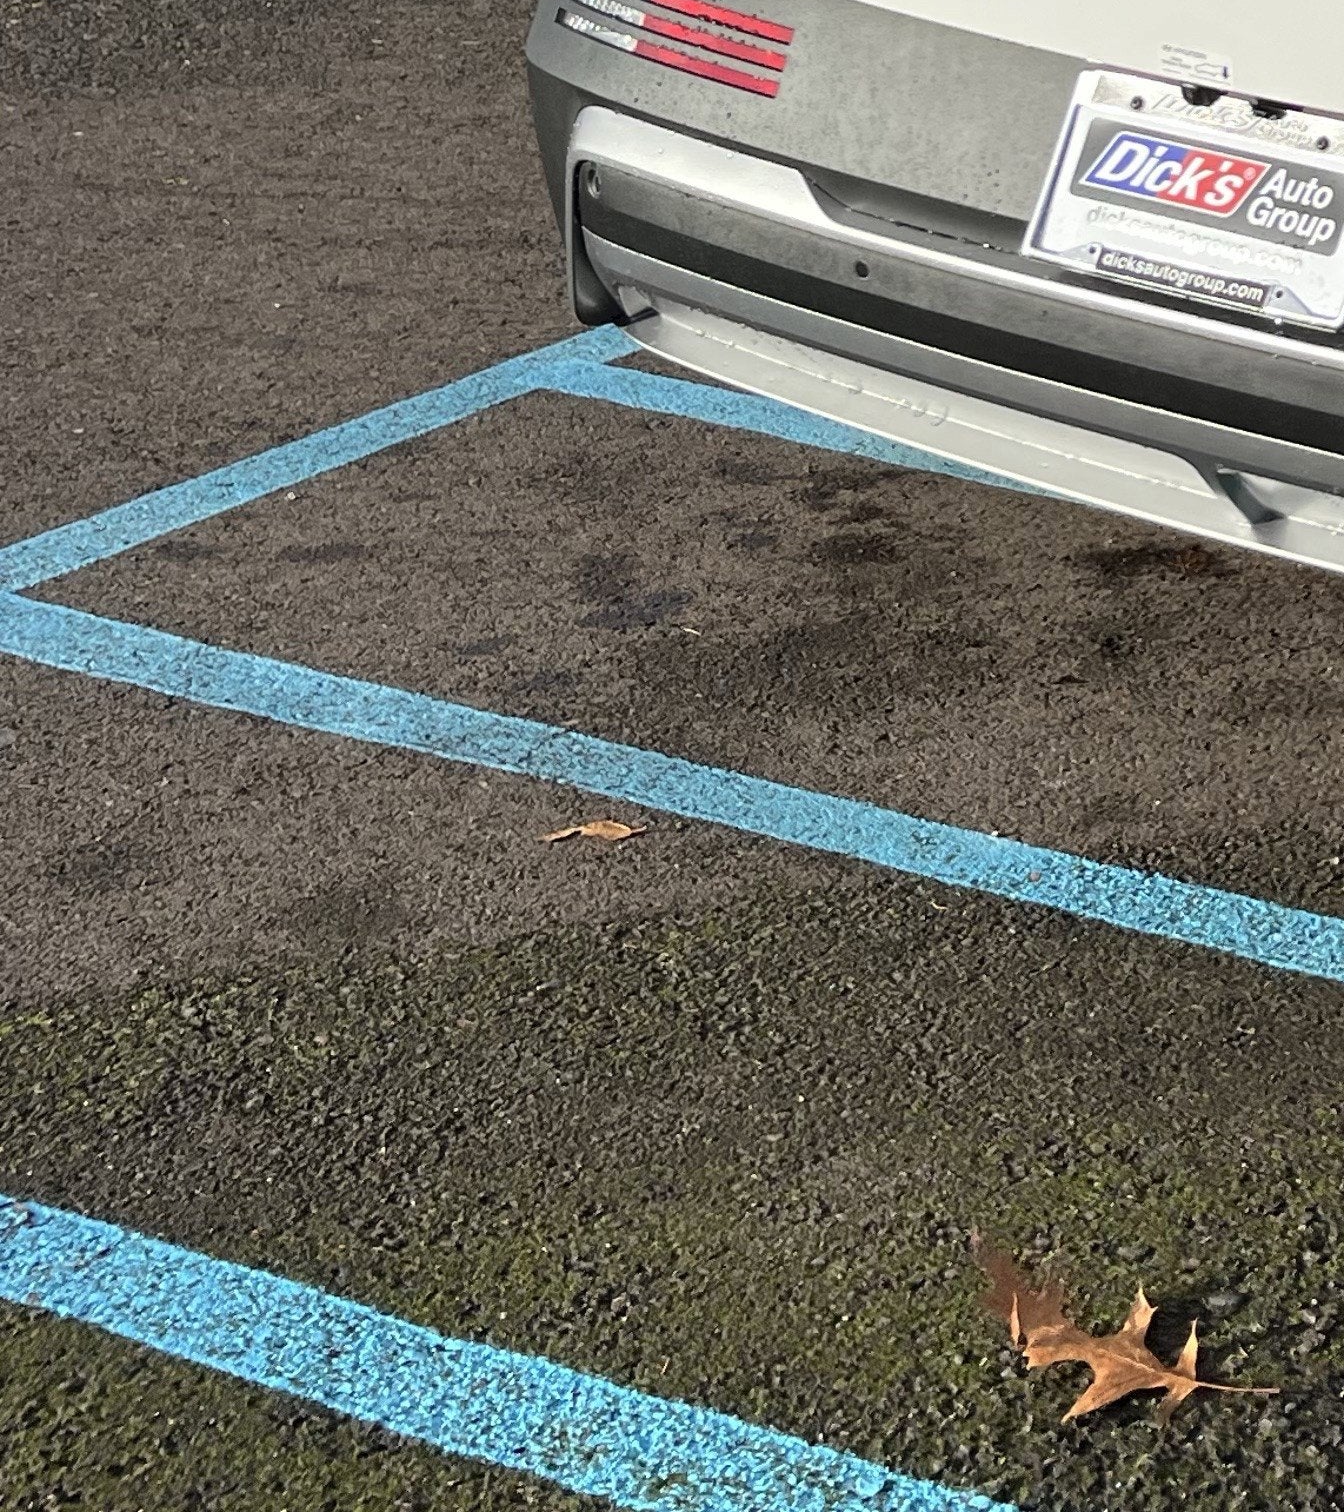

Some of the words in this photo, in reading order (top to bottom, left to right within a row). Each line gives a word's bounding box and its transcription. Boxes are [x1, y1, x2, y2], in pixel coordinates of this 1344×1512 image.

[1094, 139, 1245, 207] Dick's
[1259, 167, 1334, 210] Auto
[1246, 196, 1337, 246] Group
[1102, 251, 1264, 302] dicksautogroup.com
